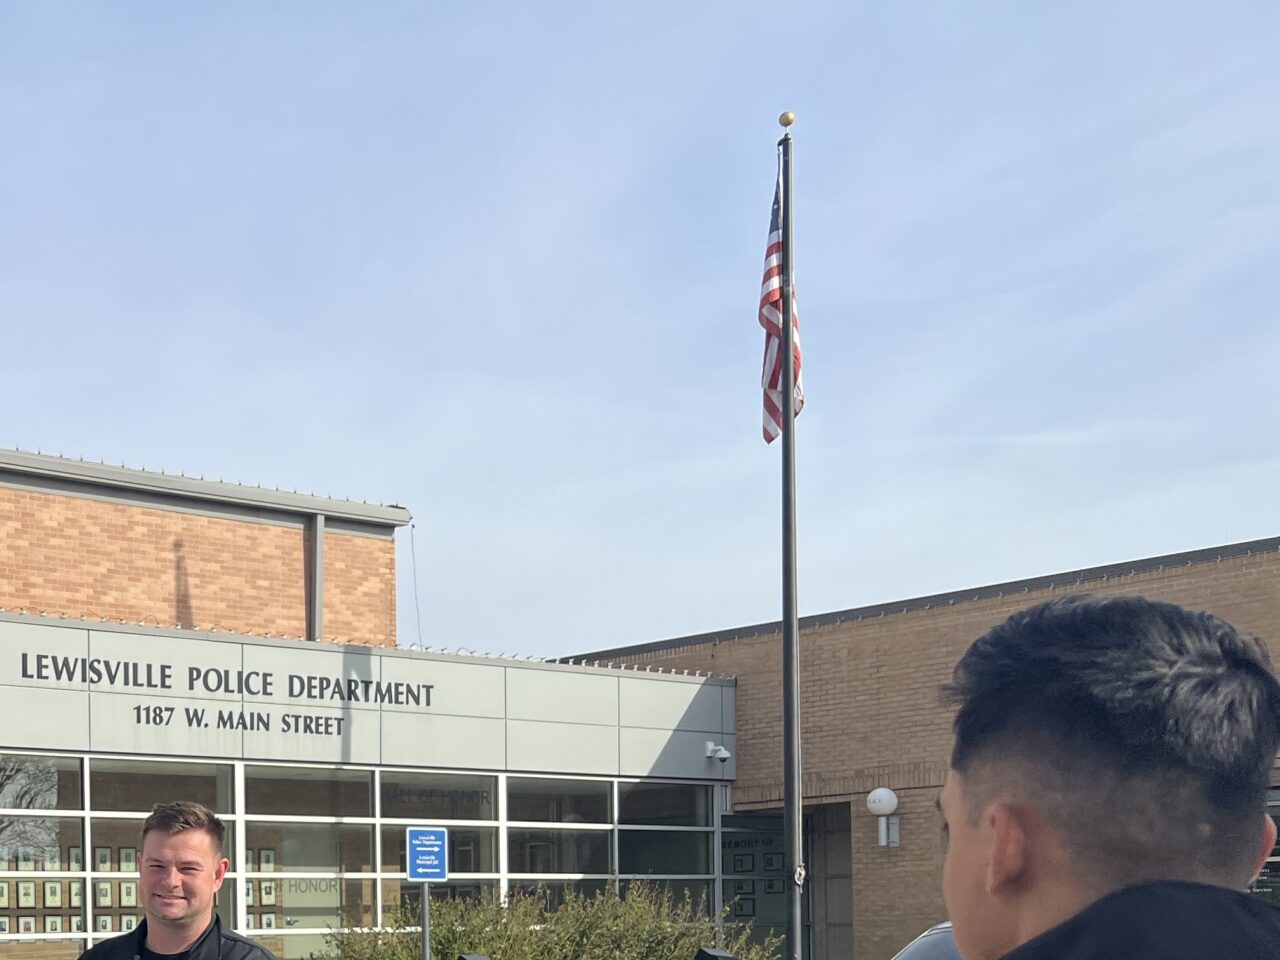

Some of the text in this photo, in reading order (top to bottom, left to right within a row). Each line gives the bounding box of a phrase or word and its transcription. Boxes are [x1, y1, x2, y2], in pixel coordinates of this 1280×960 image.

[21, 652, 434, 707] LEWISVILLE POLICE DEPARTMENT
[132, 704, 345, 736] 1187 W. MAIN STREET
[289, 878, 341, 894] HONOR
